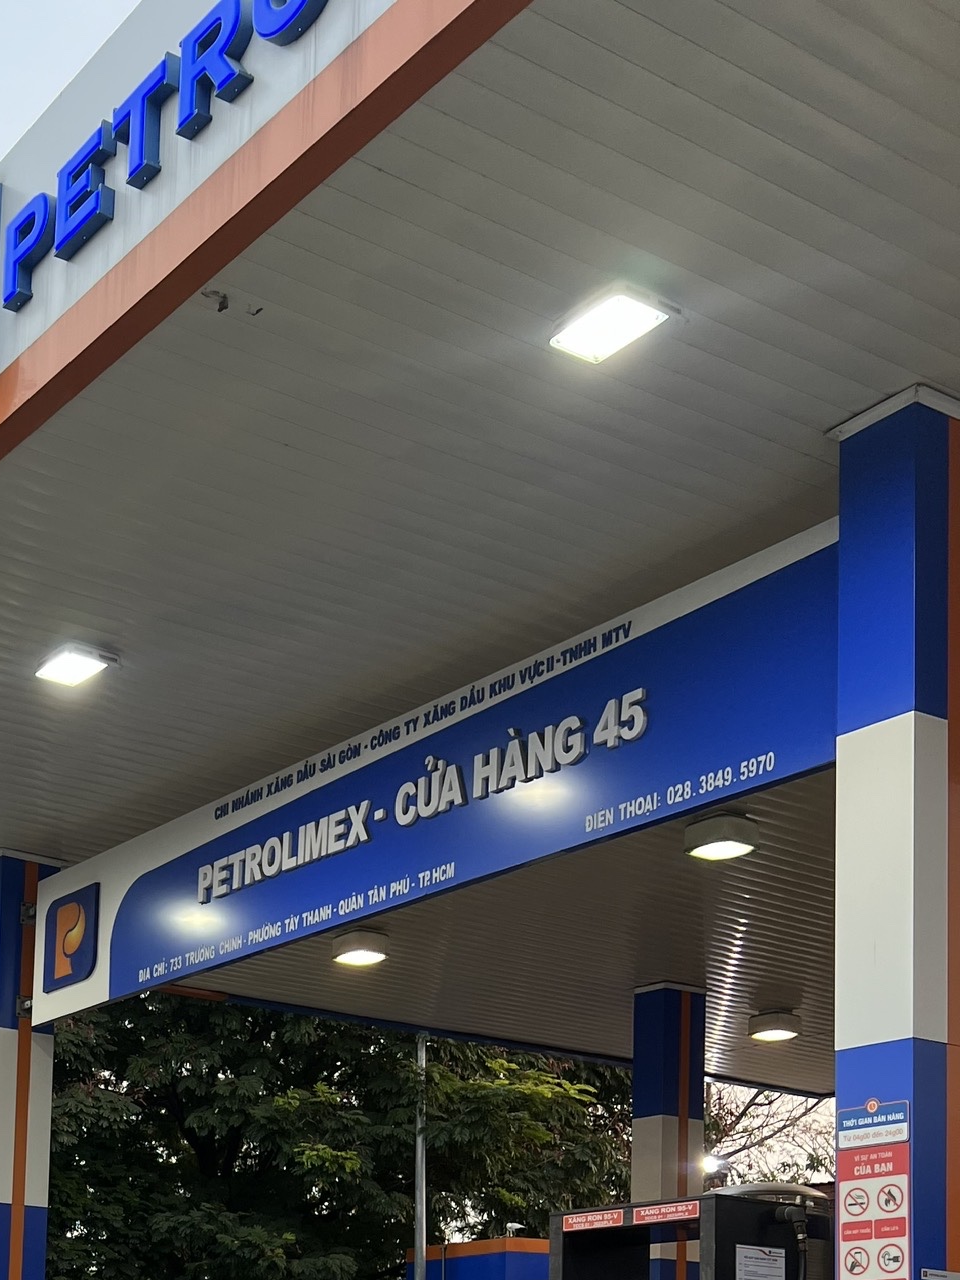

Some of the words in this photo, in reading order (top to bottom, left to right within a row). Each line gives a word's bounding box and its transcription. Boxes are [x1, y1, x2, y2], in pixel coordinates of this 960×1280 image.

[214, 806, 229, 820] CHI
[231, 787, 263, 813] NHÁNH
[266, 774, 294, 798] XĂNG
[319, 753, 336, 773] SÀI
[339, 742, 361, 764] GÒN
[370, 725, 401, 750] CÔNG
[404, 716, 419, 735] TY
[423, 701, 456, 727] XĂNG
[489, 673, 515, 698] KHU
[601, 621, 632, 649] MTV
[198, 800, 372, 902] PETROLIMEX
[395, 755, 466, 828] CỬA
[473, 715, 585, 799] HÀNG
[593, 688, 646, 749] 45
[138, 968, 150, 983] ĐỊA
[169, 956, 182, 972] 733
[219, 935, 242, 955] CHINH
[367, 885, 386, 906] TÂN
[390, 874, 410, 899] PHÚ
[858, 1116, 872, 1125] GIAN
[873, 1114, 886, 1123] BÁN
[887, 1112, 904, 1121] HÀNG
[854, 1162, 871, 1176] CỦA
[874, 1162, 893, 1175] BẠN
[587, 1214, 603, 1223] RON
[603, 1212, 618, 1220] 95-V
